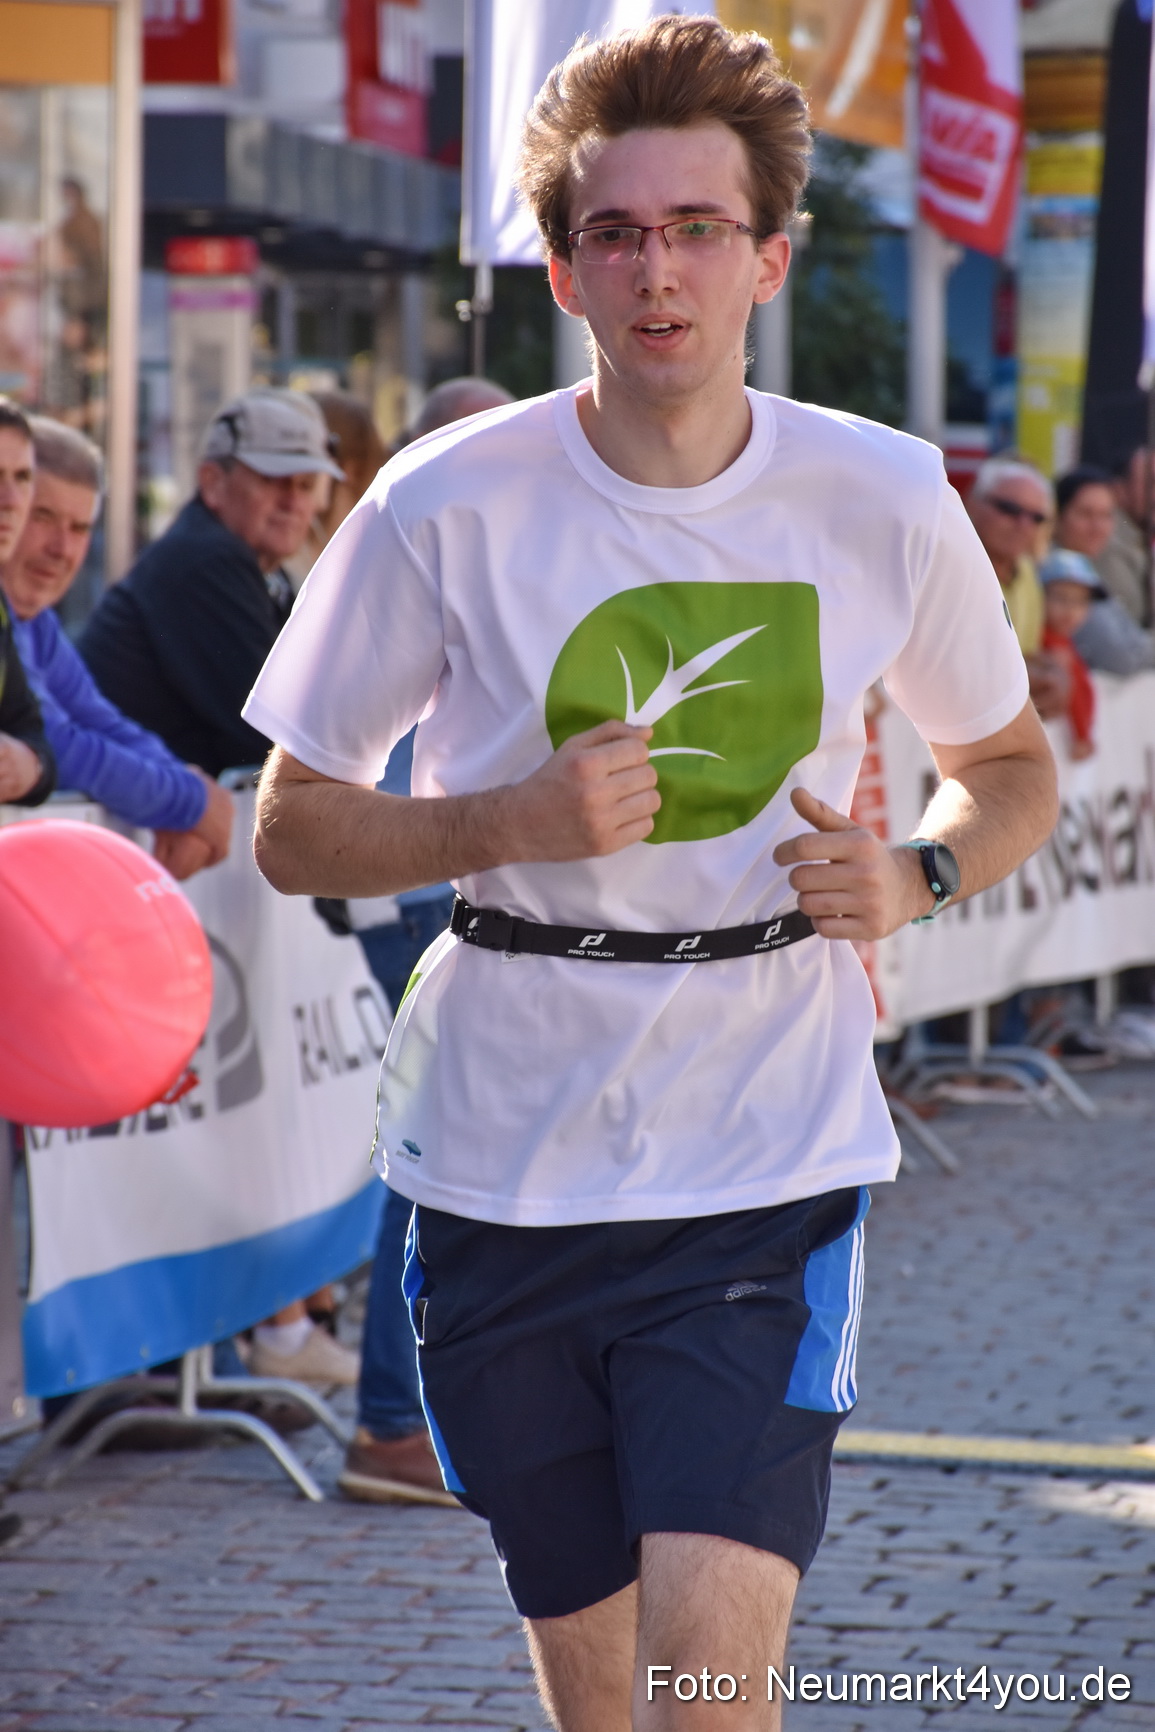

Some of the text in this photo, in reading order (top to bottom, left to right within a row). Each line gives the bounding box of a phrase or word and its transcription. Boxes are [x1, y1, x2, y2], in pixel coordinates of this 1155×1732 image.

[754, 936, 790, 951] PRO TOUCH
[587, 950, 615, 958] TOUCH
[683, 952, 711, 960] TOUCH
